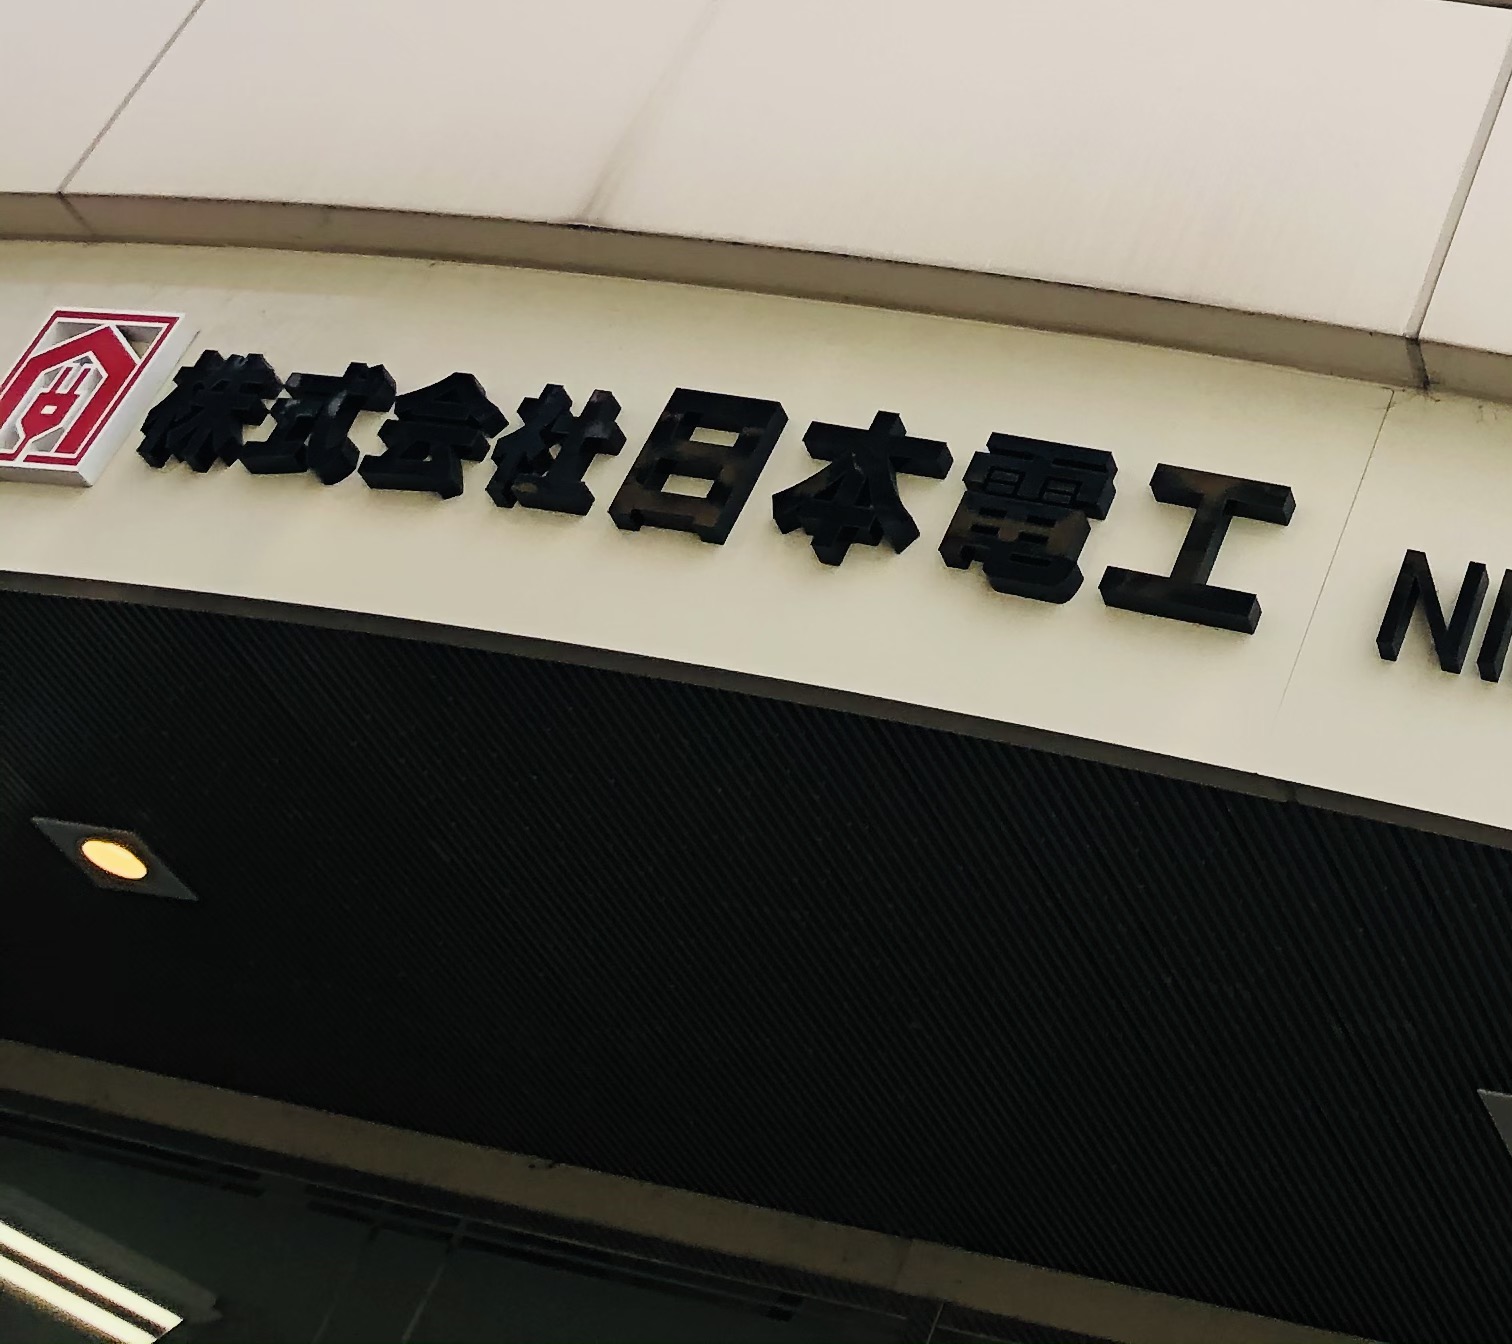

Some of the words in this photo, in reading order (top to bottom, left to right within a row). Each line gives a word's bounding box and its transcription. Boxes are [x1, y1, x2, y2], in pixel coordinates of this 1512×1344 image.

[136, 349, 1297, 636] 株式会社日本電工
